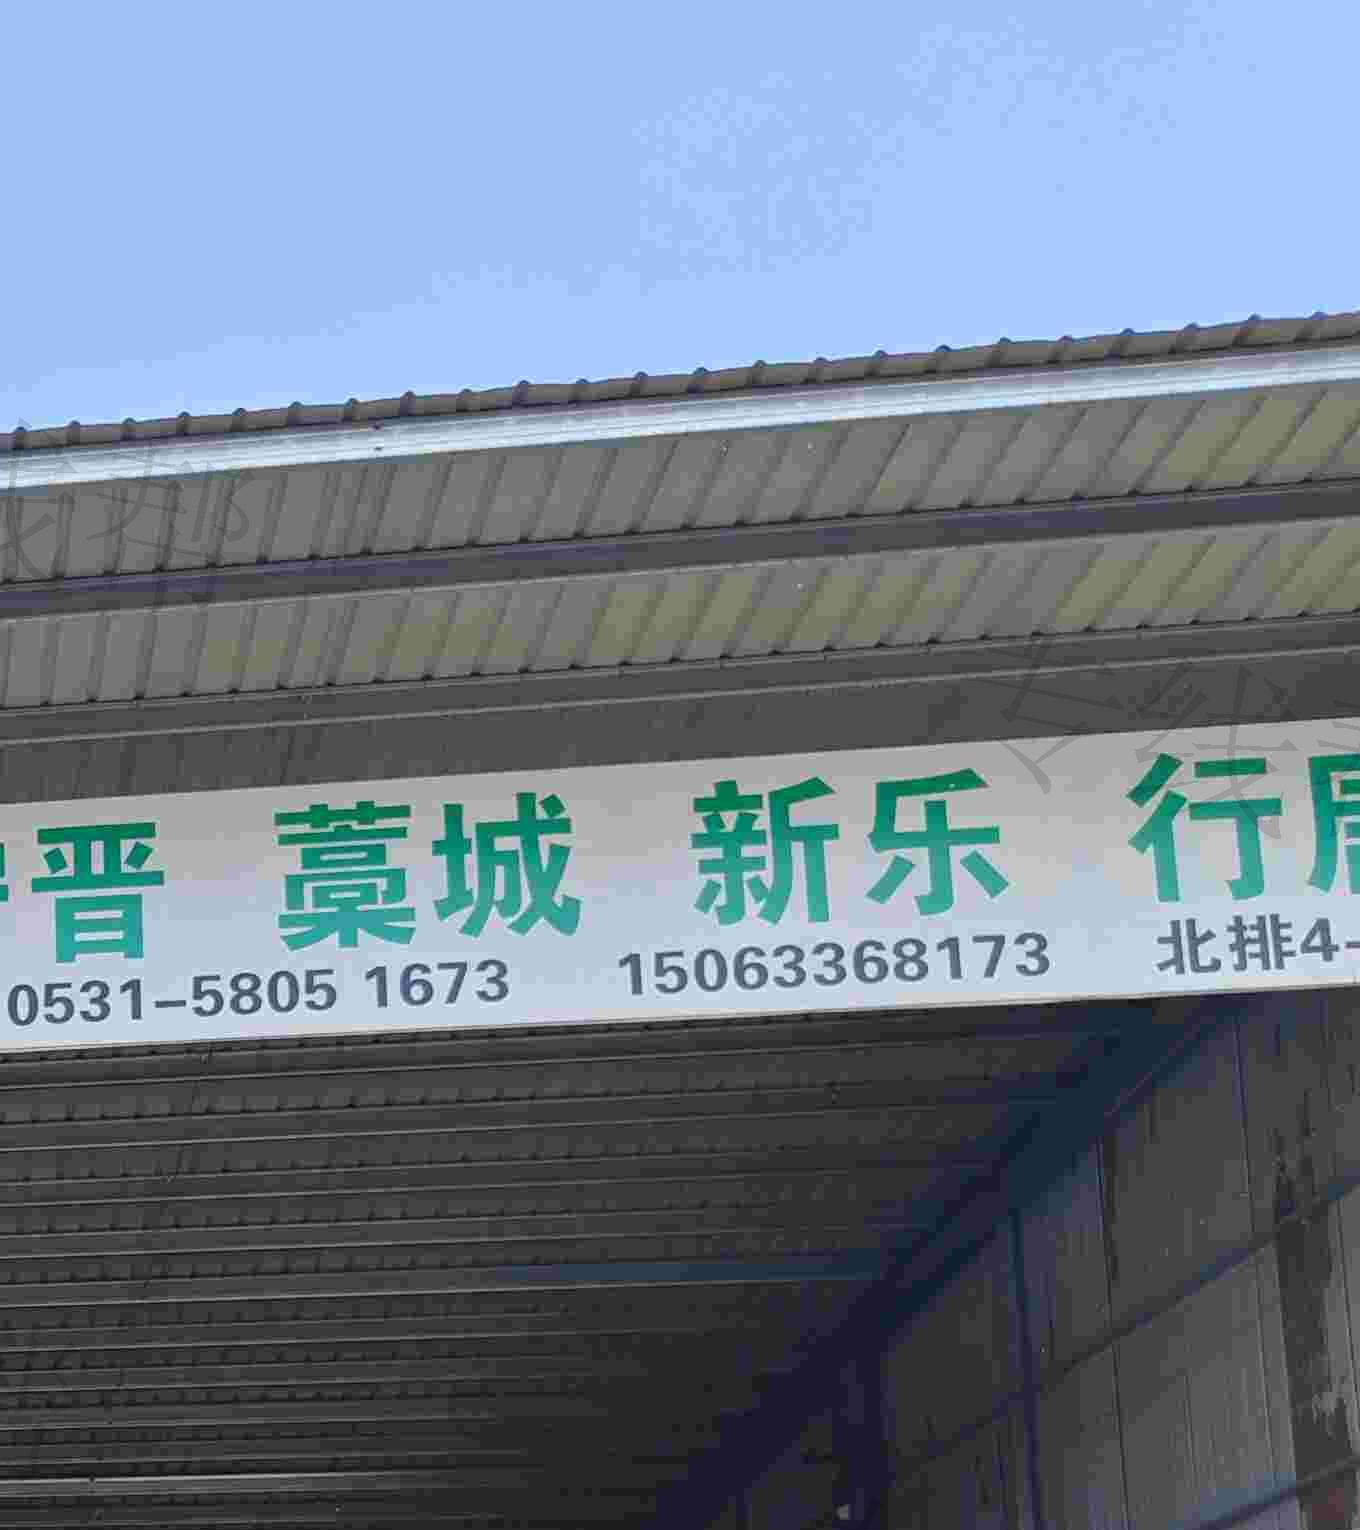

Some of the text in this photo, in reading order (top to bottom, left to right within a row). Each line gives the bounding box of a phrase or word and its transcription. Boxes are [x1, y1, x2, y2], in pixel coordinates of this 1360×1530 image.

[273, 791, 582, 952] 藁城
[690, 767, 1009, 926] 新乐
[618, 931, 1051, 997] 15063368173
